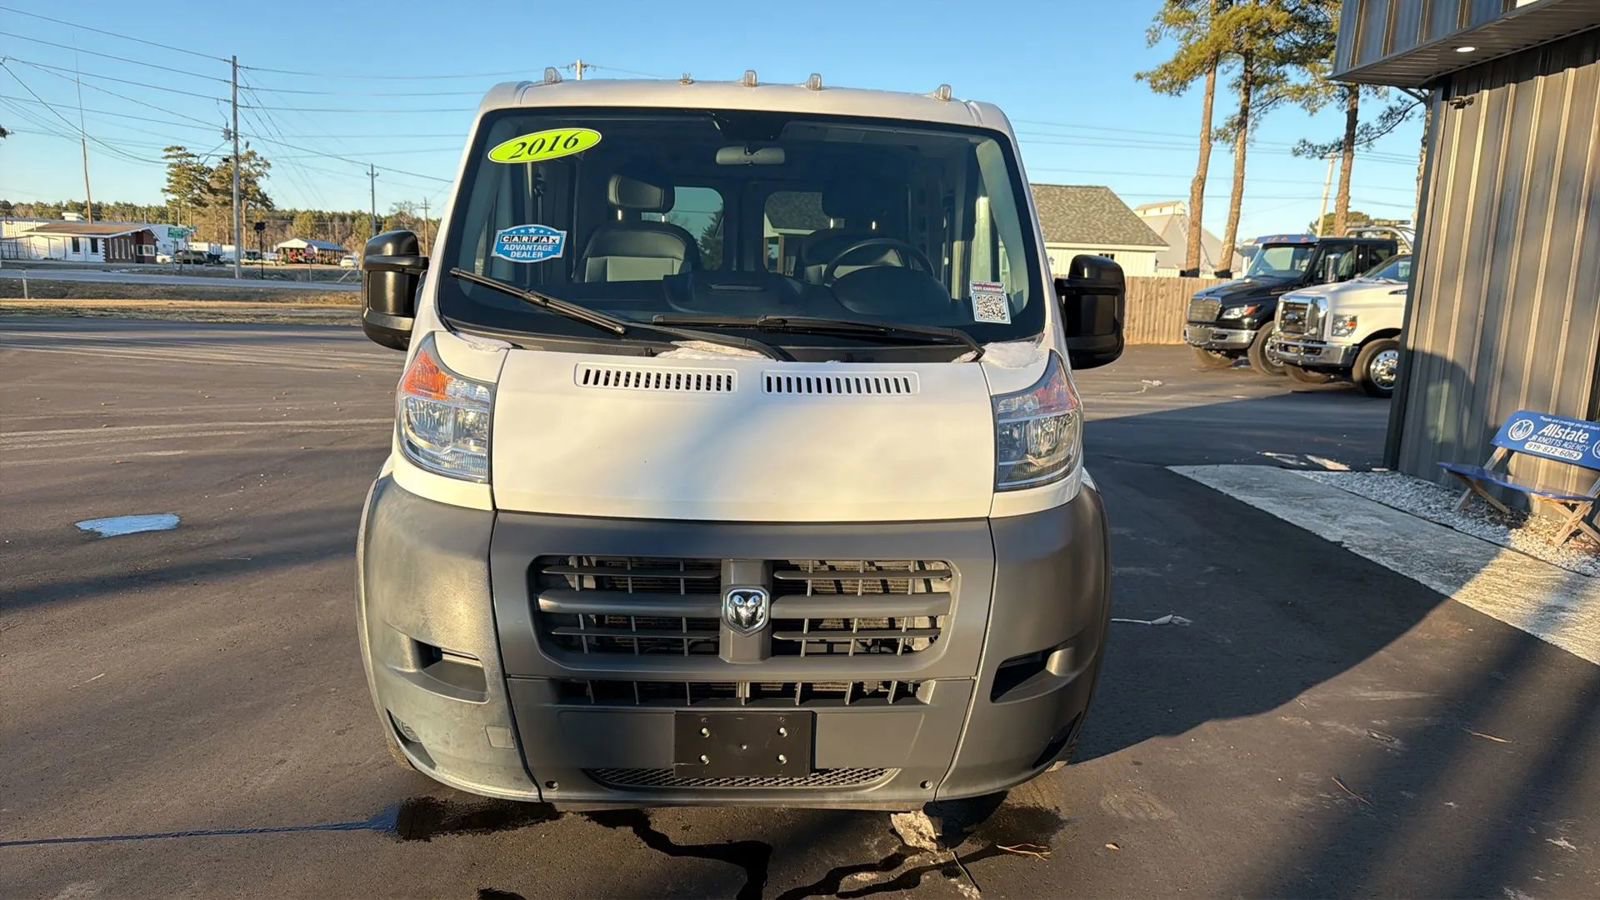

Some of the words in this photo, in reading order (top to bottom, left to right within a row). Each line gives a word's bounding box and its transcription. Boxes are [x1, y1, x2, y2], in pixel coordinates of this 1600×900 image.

[507, 131, 583, 159] 2016
[501, 235, 560, 244] CARFAX
[1537, 423, 1589, 443] Allstate
[1561, 441, 1591, 452] AGENCY
